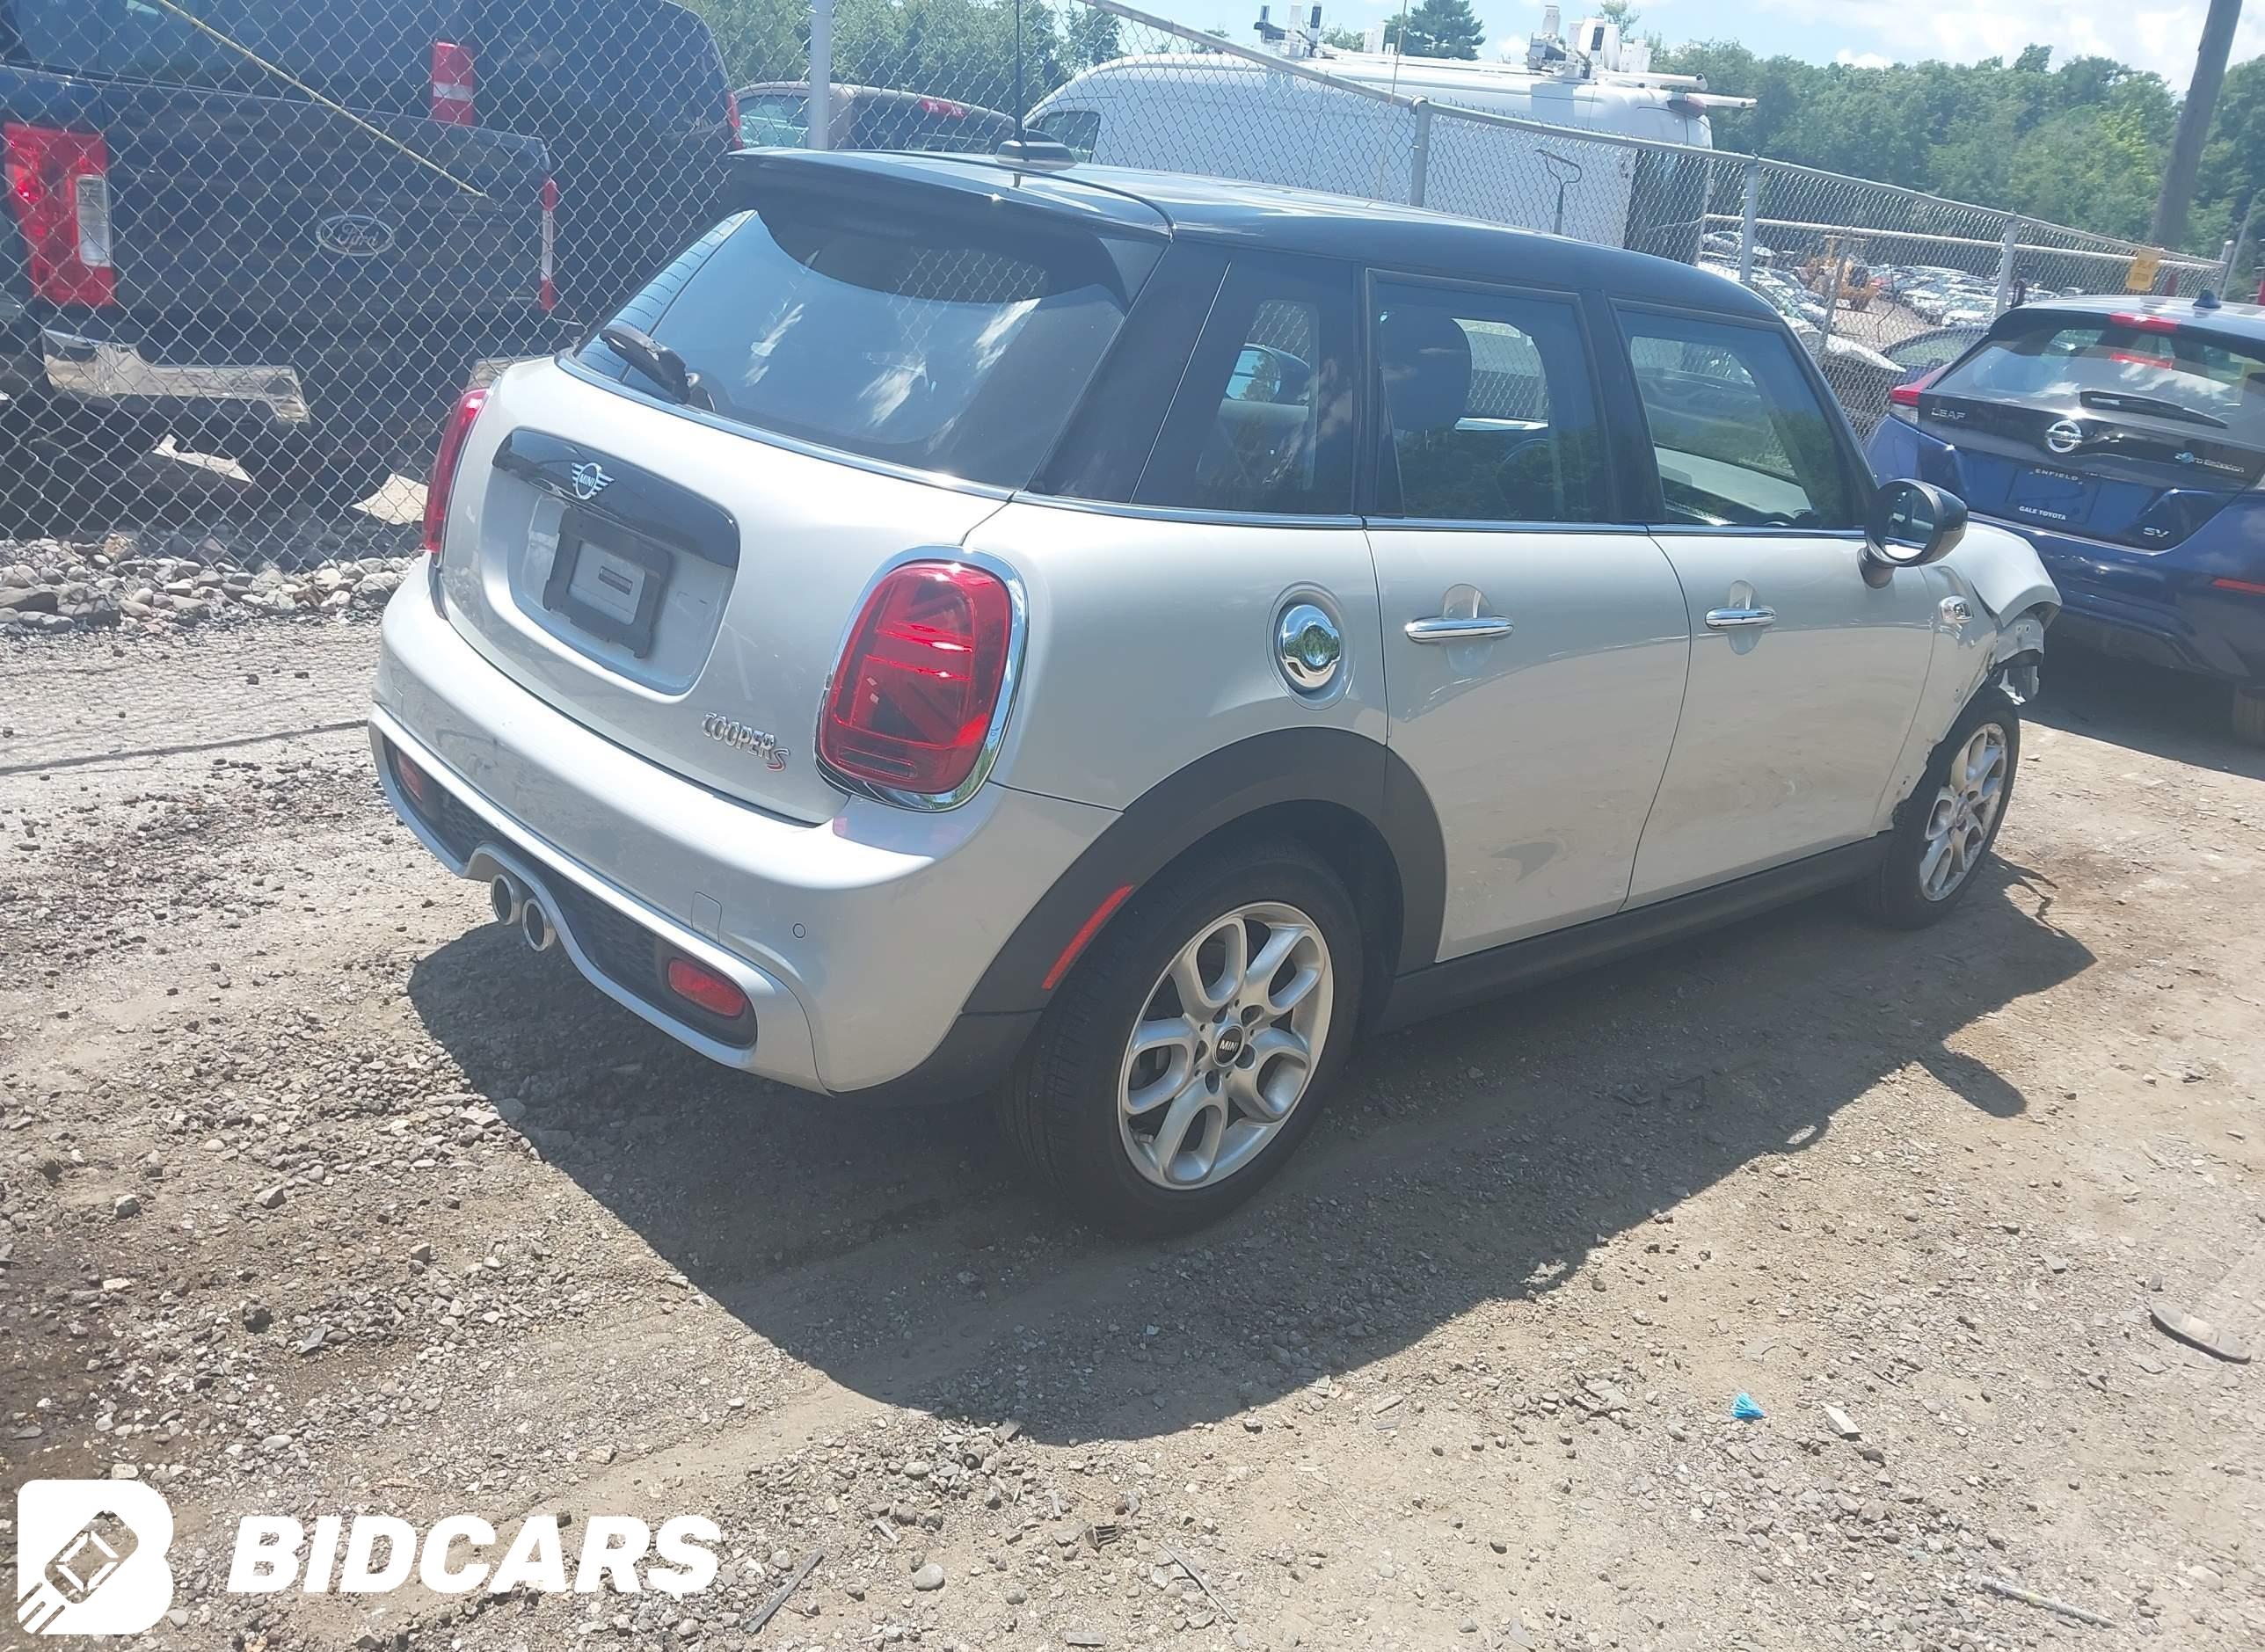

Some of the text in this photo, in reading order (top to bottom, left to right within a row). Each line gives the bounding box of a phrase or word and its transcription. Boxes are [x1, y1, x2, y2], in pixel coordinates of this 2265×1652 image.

[338, 221, 379, 247] Ford
[1931, 407, 1966, 420] LEAF
[579, 473, 595, 488] MINI
[2035, 468, 2079, 481] ENFIELD
[2039, 509, 2066, 520] TOYOTA
[2143, 527, 2170, 538] SV
[702, 711, 790, 772] COOPER S
[1219, 1039, 1239, 1053] MINI
